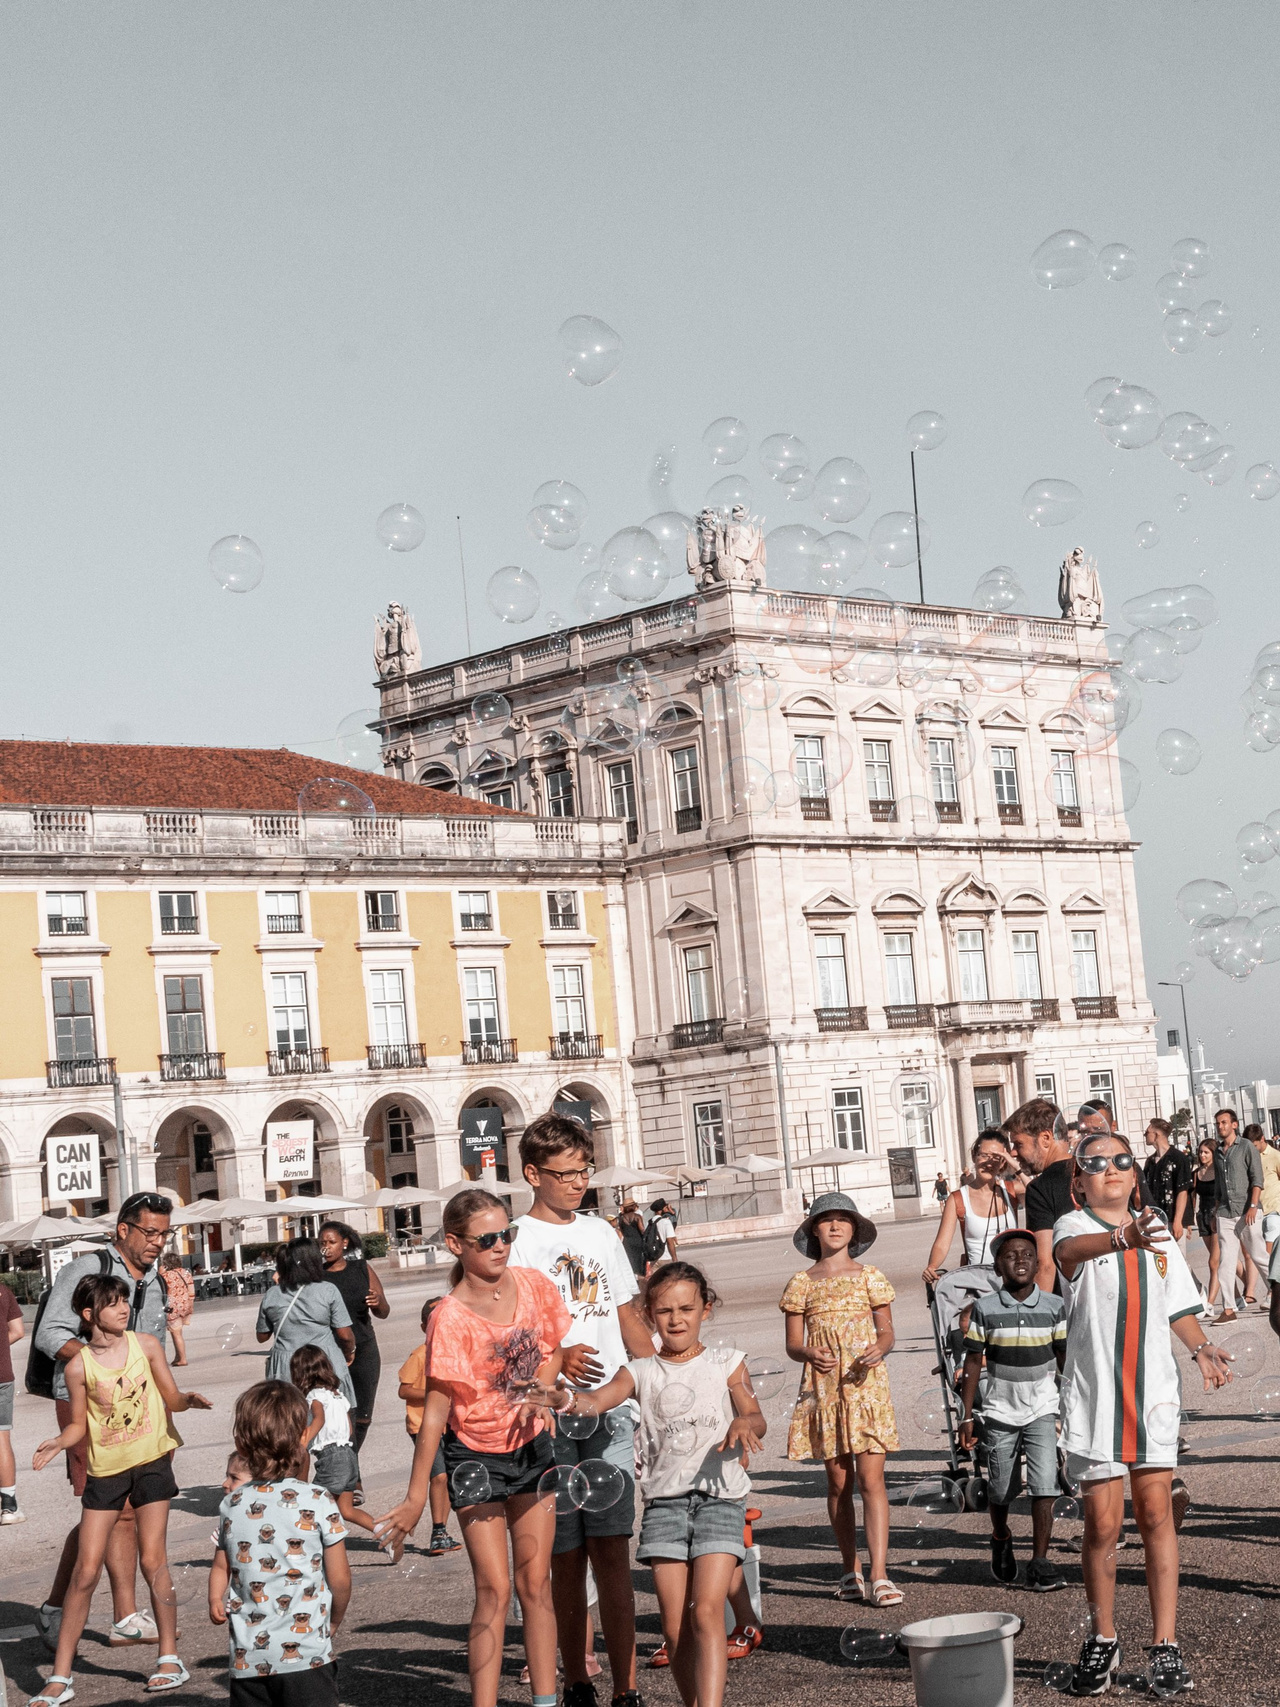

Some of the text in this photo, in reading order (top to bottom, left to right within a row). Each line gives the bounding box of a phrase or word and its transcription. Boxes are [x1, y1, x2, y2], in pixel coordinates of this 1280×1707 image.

[272, 1137, 309, 1148] SEXIEST
[465, 1135, 499, 1144] TERRA NOVA
[56, 1142, 91, 1164] CAN
[278, 1146, 296, 1156] WC
[279, 1155, 306, 1163] EARTH
[283, 1169, 309, 1178] Renova
[57, 1170, 92, 1192] CAN
[588, 1257, 611, 1302] HOLIDAYS
